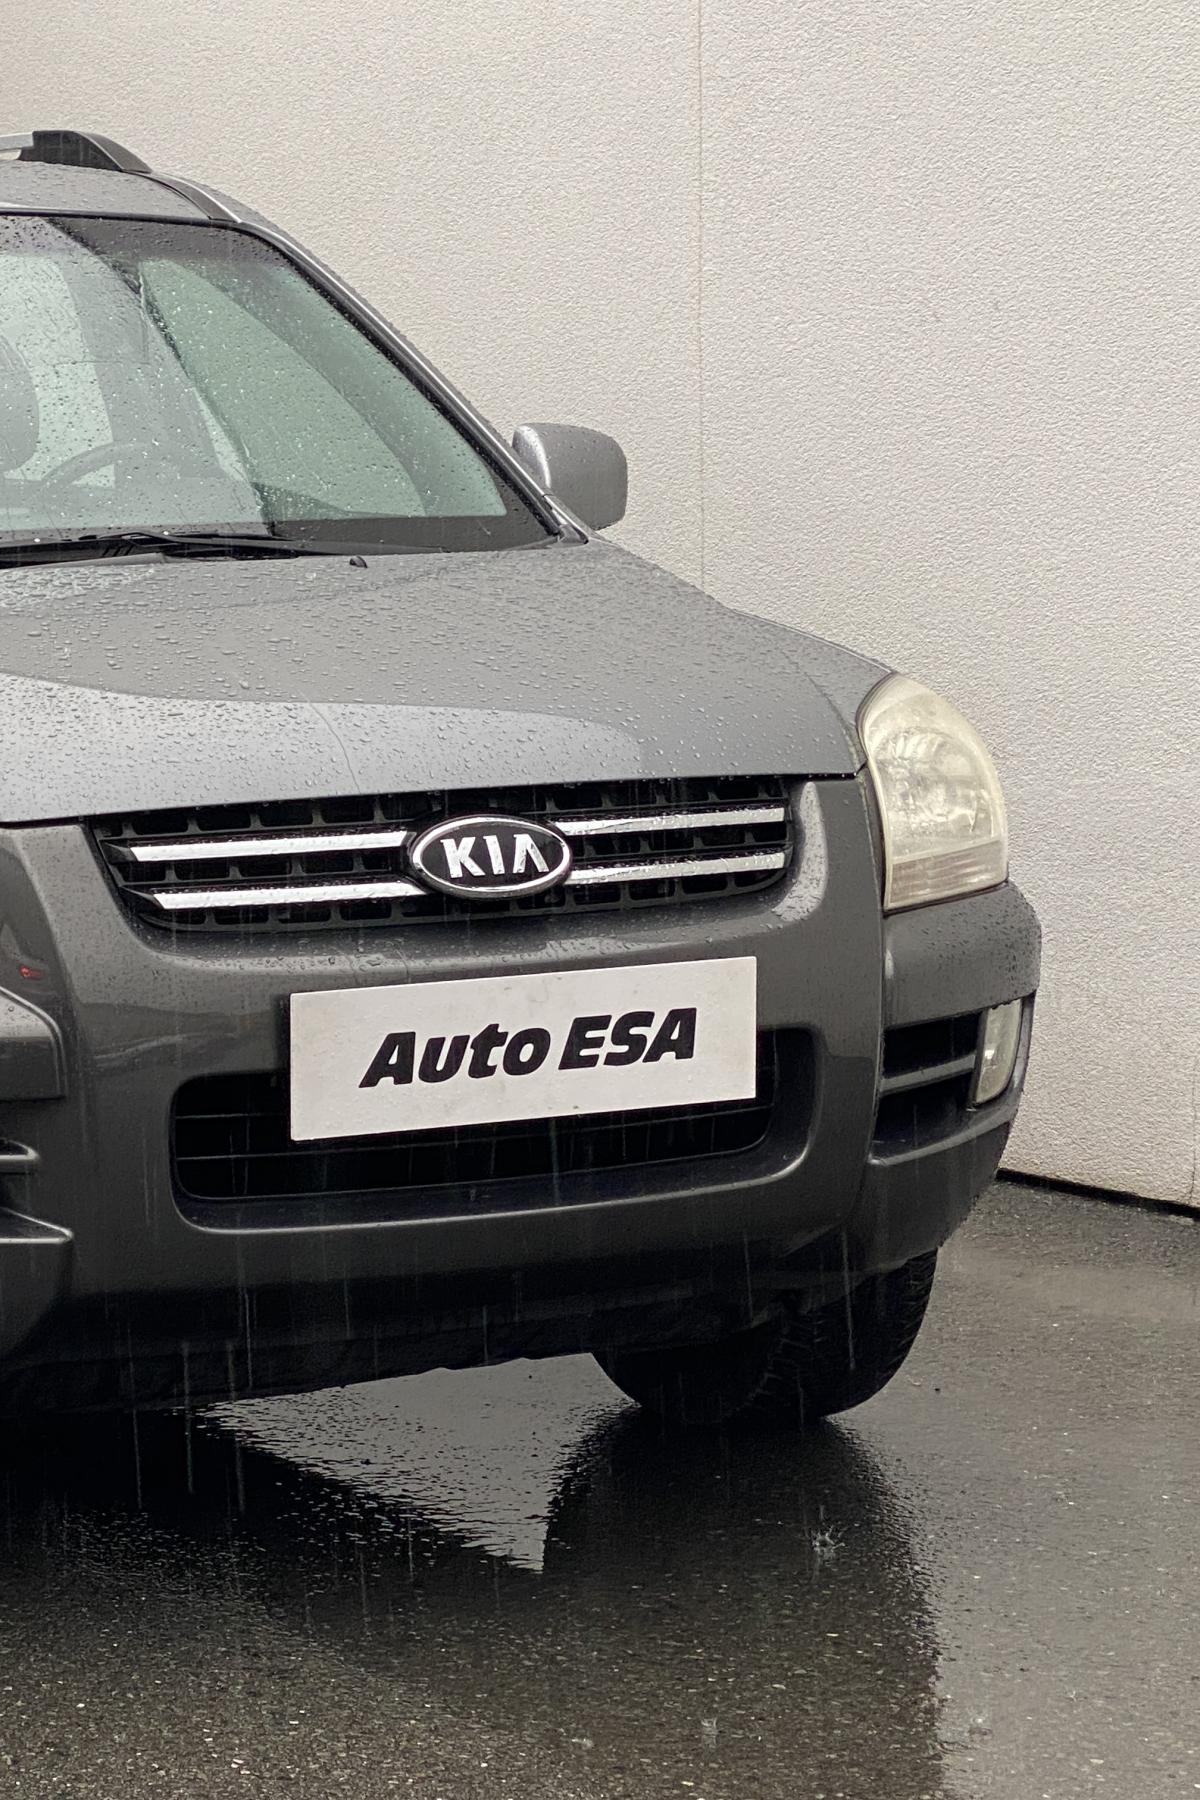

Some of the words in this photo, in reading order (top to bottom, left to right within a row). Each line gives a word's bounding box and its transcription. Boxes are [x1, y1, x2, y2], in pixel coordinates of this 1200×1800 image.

[440, 833, 549, 878] KIA
[359, 1024, 551, 1088] Auto
[558, 1008, 697, 1070] ESA
